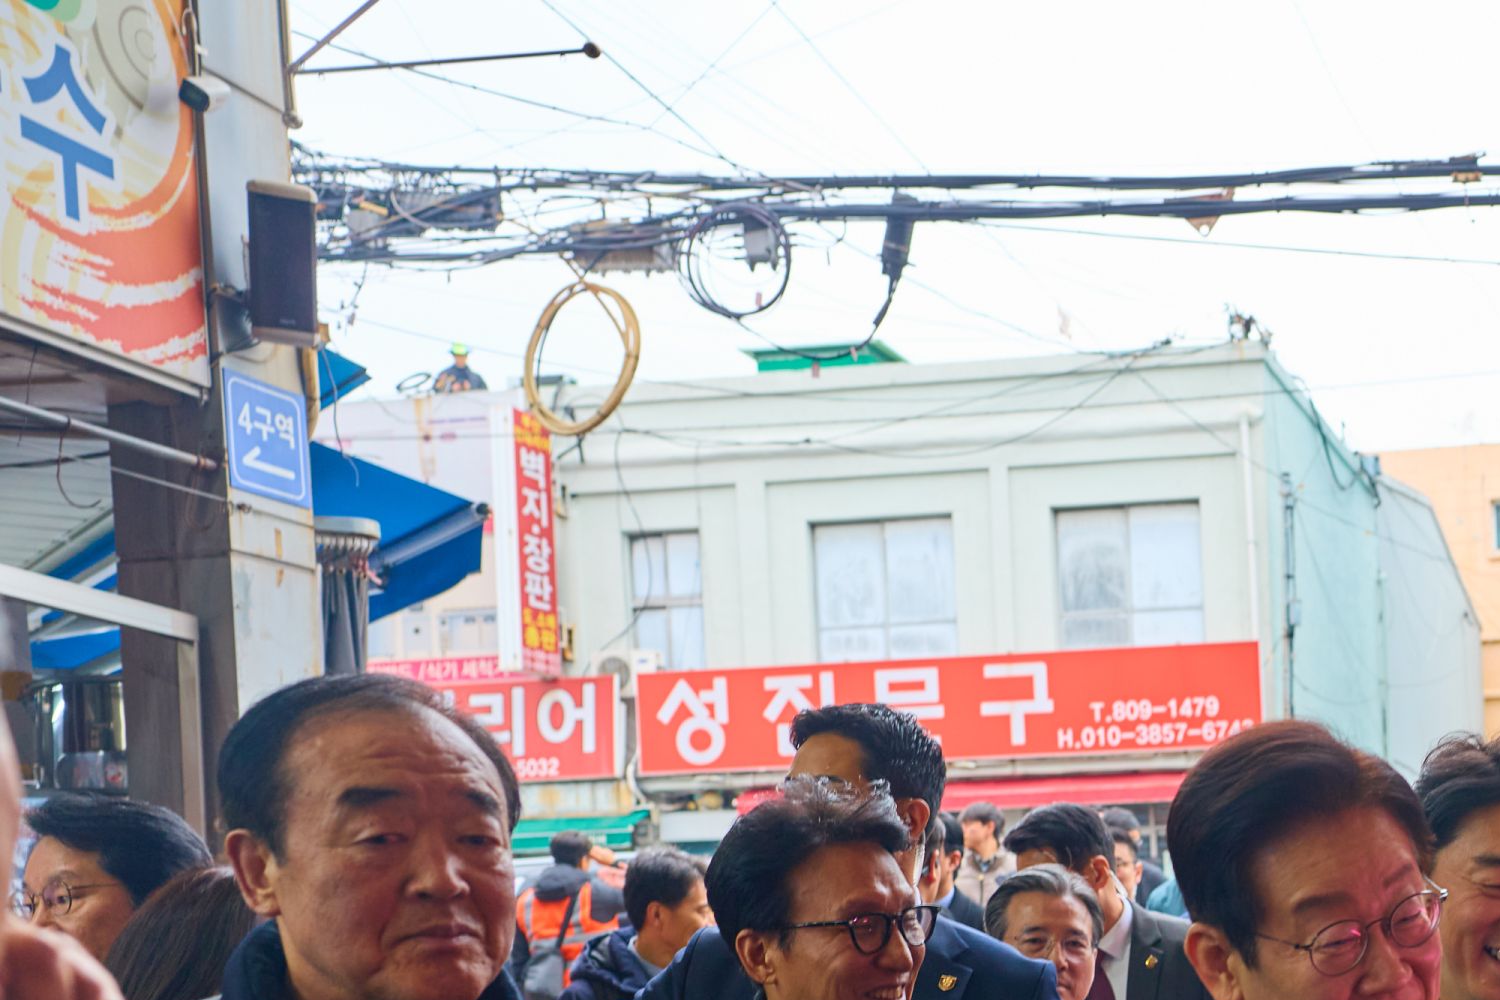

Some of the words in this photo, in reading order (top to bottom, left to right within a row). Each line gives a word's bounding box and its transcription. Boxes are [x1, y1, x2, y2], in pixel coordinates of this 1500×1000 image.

[20, 44, 114, 221] 수
[238, 401, 295, 449] 4구역
[441, 683, 596, 757] 리어
[513, 757, 561, 776] 5032
